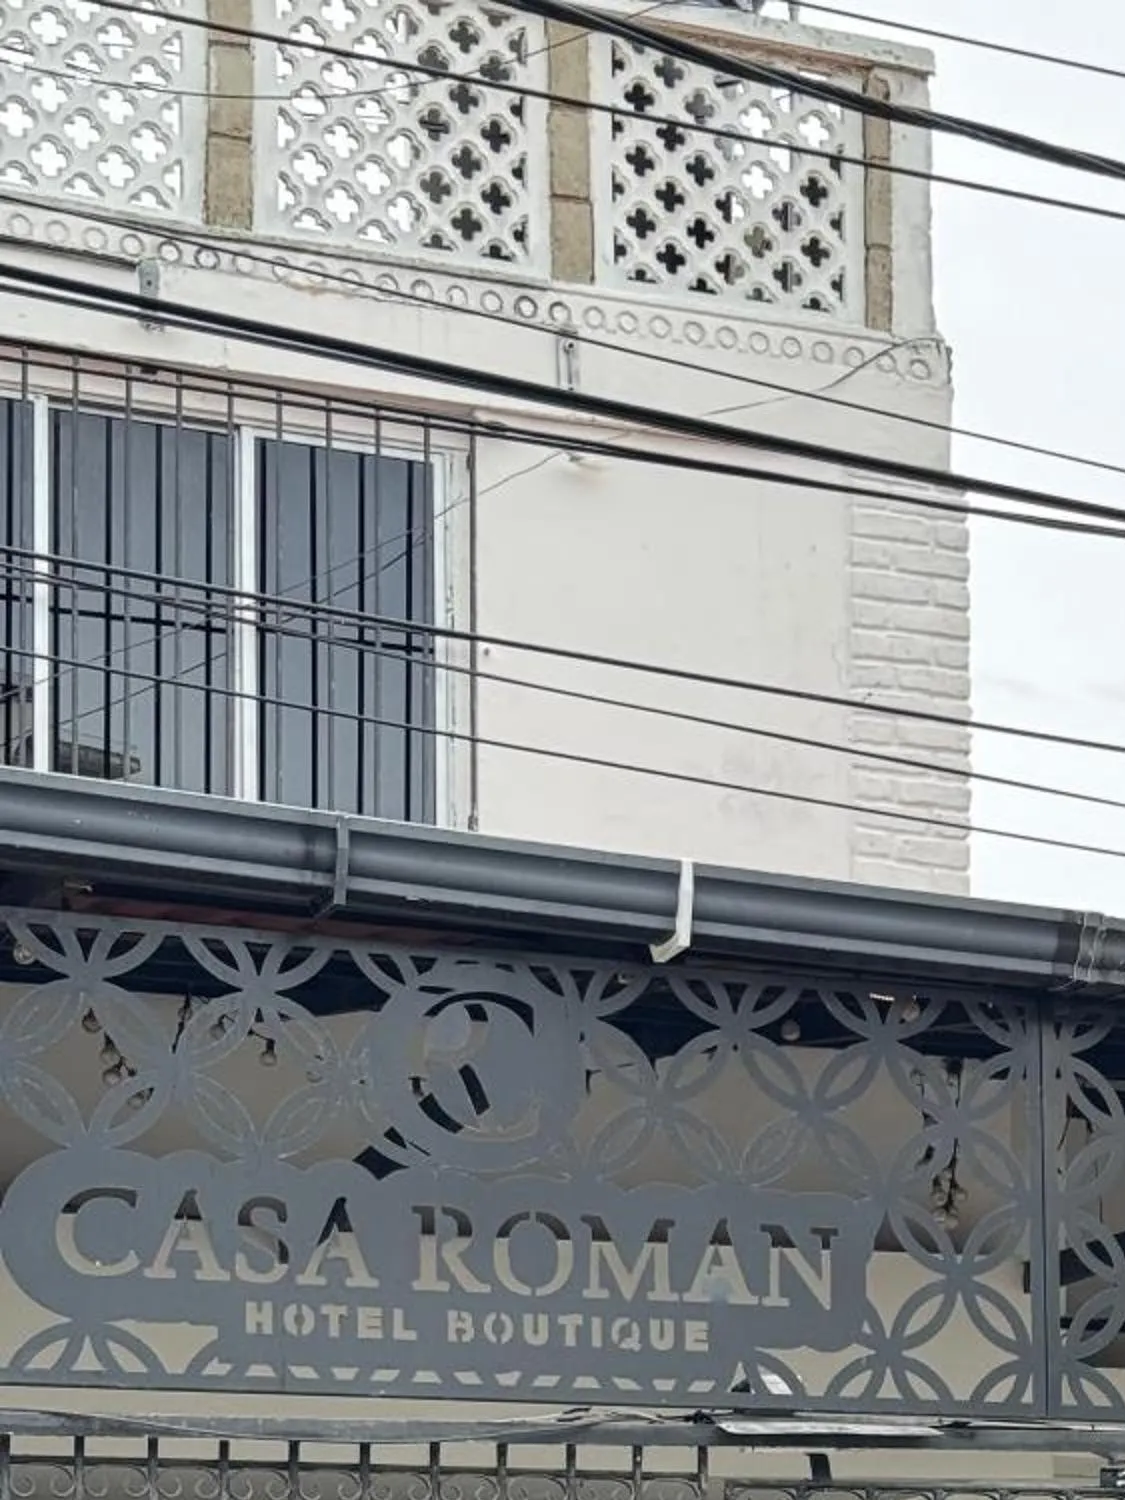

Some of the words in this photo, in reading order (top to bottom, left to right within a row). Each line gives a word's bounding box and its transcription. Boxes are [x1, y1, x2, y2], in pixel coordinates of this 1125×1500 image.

[54, 1187, 380, 1288] CASA
[411, 1205, 841, 1311] ROMAN
[244, 1300, 417, 1342] HOTEL
[446, 1311, 711, 1352] BOUTIQUE
